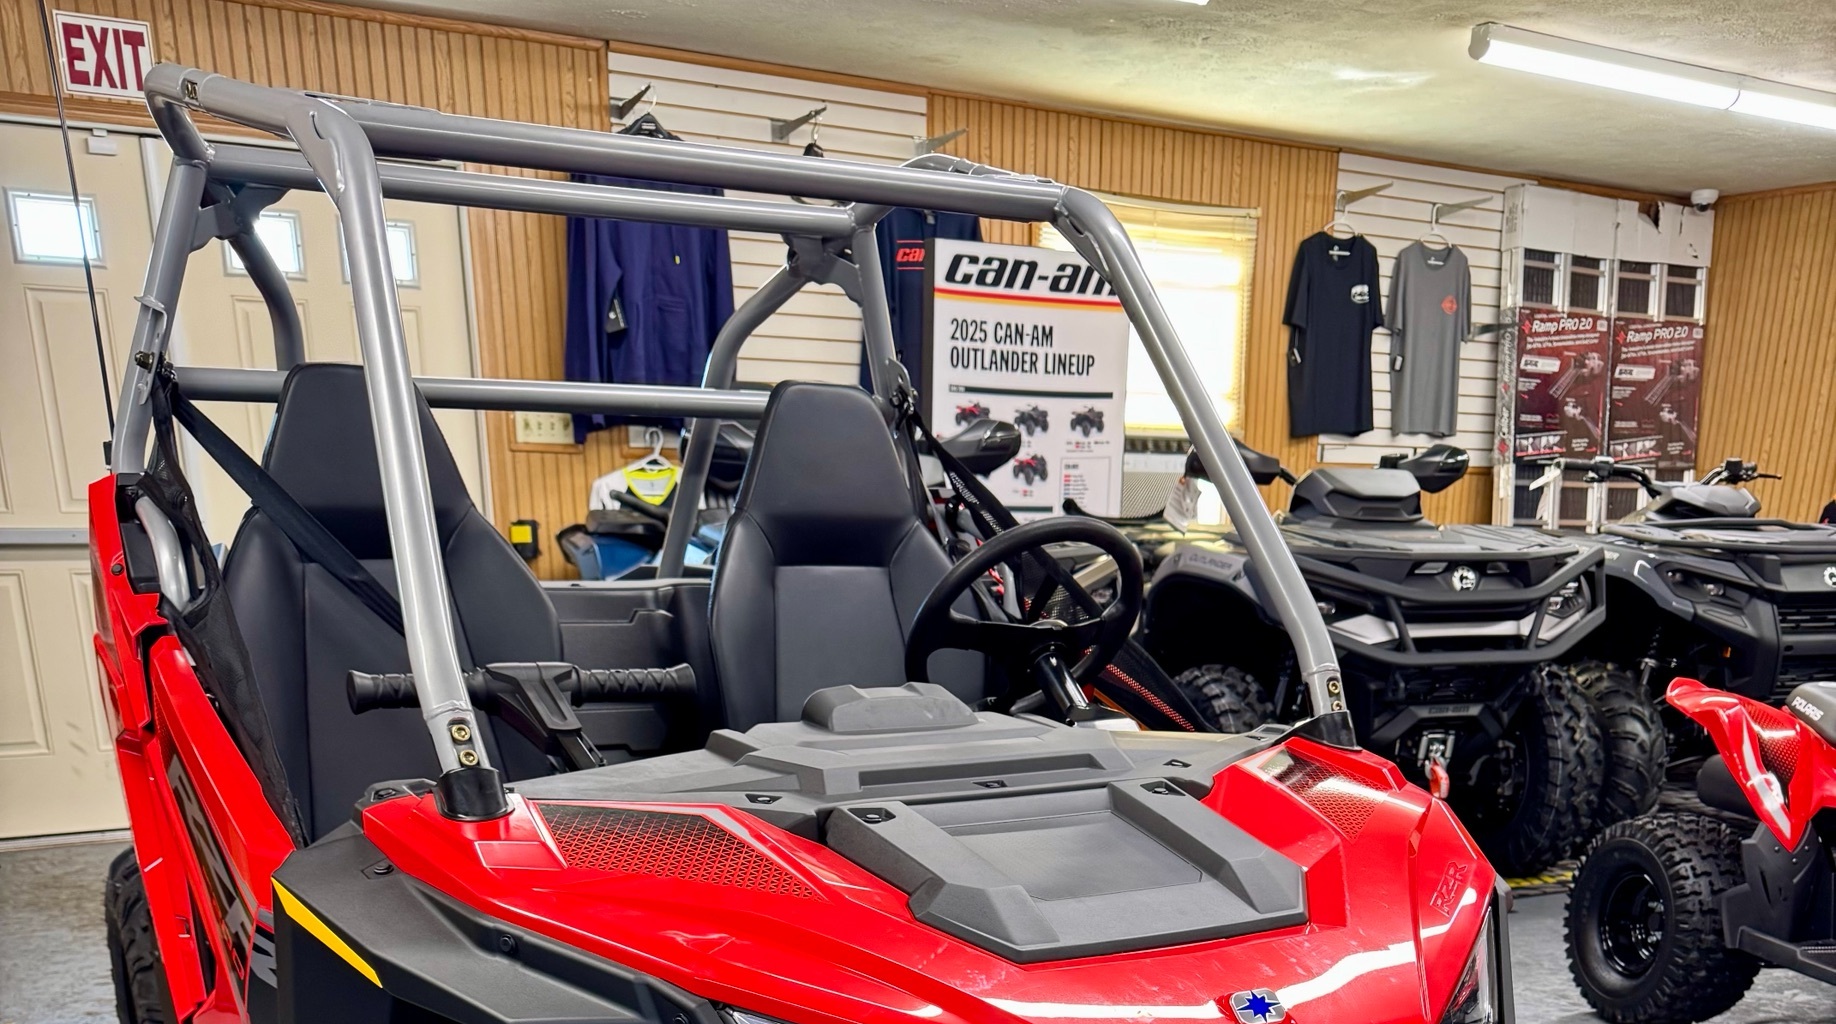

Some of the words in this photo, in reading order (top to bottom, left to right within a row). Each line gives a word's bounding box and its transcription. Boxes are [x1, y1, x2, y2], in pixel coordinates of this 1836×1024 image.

[61, 22, 146, 91] EXIT
[950, 318, 988, 343] 2025
[994, 321, 1054, 348] CAN-AM
[1531, 320, 1559, 335] Ramp
[1559, 317, 1579, 332] PRO
[1626, 330, 1653, 343] Ramp
[1653, 328, 1674, 340] PRO
[950, 346, 1038, 374] OUTLANDER
[1044, 353, 1095, 377] LINEUP
[1791, 695, 1825, 721] POLARIS
[1429, 860, 1468, 918] RZR
